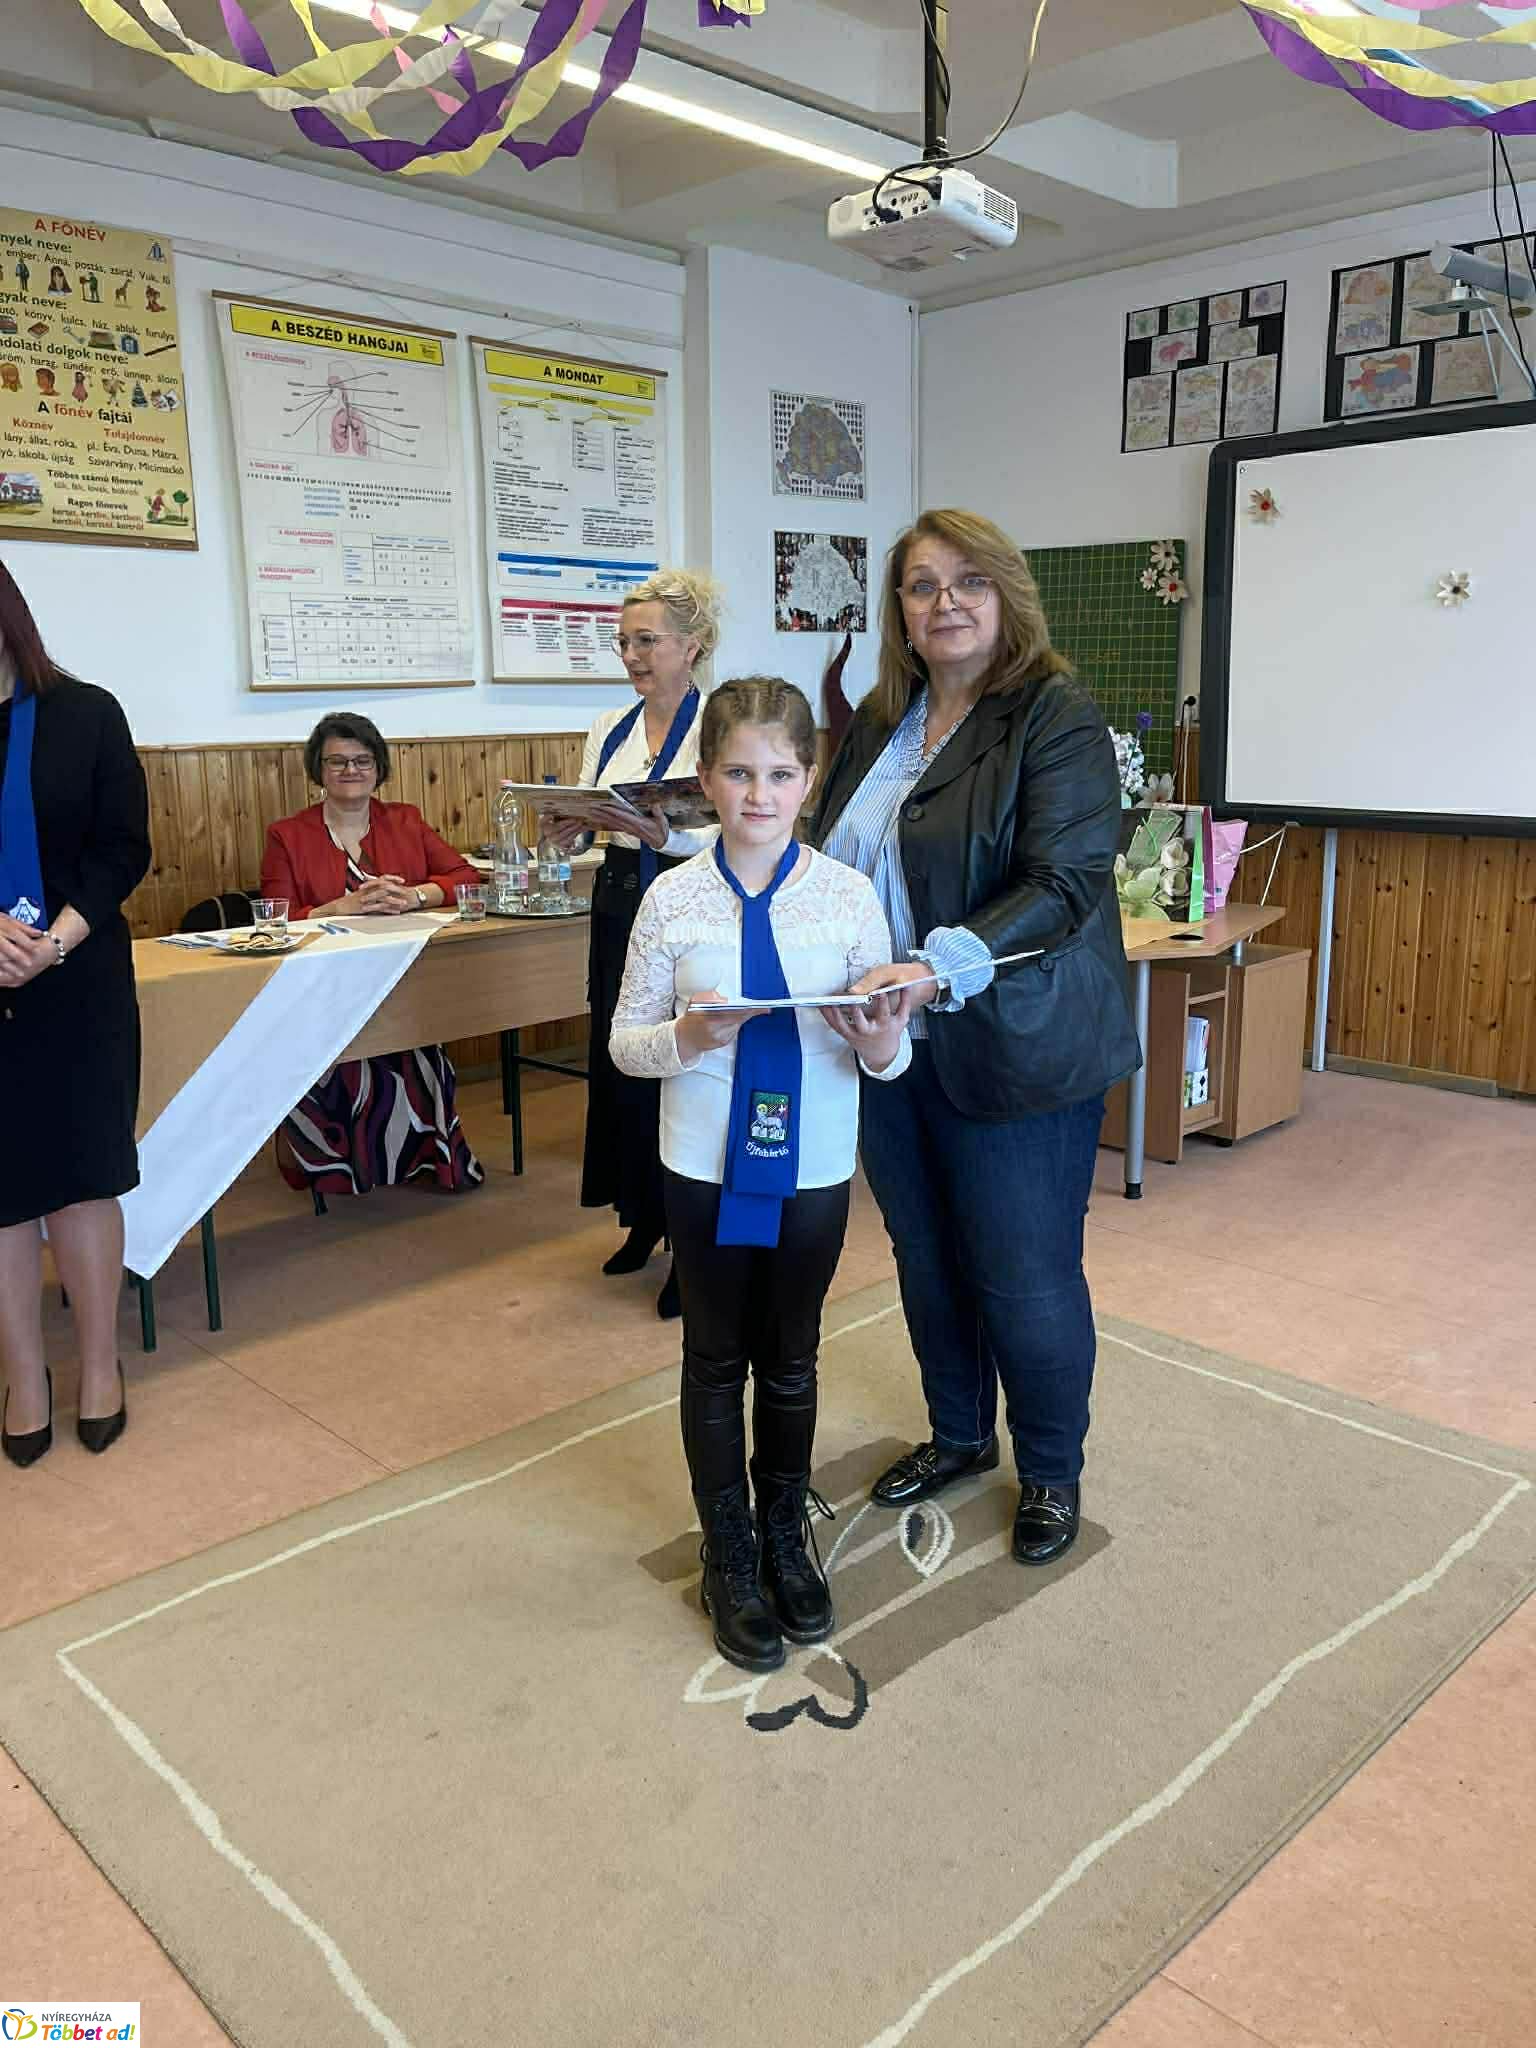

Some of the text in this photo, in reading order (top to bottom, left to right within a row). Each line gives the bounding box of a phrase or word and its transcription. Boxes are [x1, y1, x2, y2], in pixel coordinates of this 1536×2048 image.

[34, 218, 47, 232] A
[37, 239, 72, 252] neve:
[32, 296, 67, 310] neve:
[271, 319, 281, 332] A
[286, 321, 343, 343] BESZÉD
[348, 331, 409, 354] HANGJAI
[47, 343, 90, 360] dolgok
[95, 352, 128, 366] neve:
[543, 365, 604, 385] A MONDAT
[38, 400, 50, 414] A
[98, 408, 132, 424] fajtái
